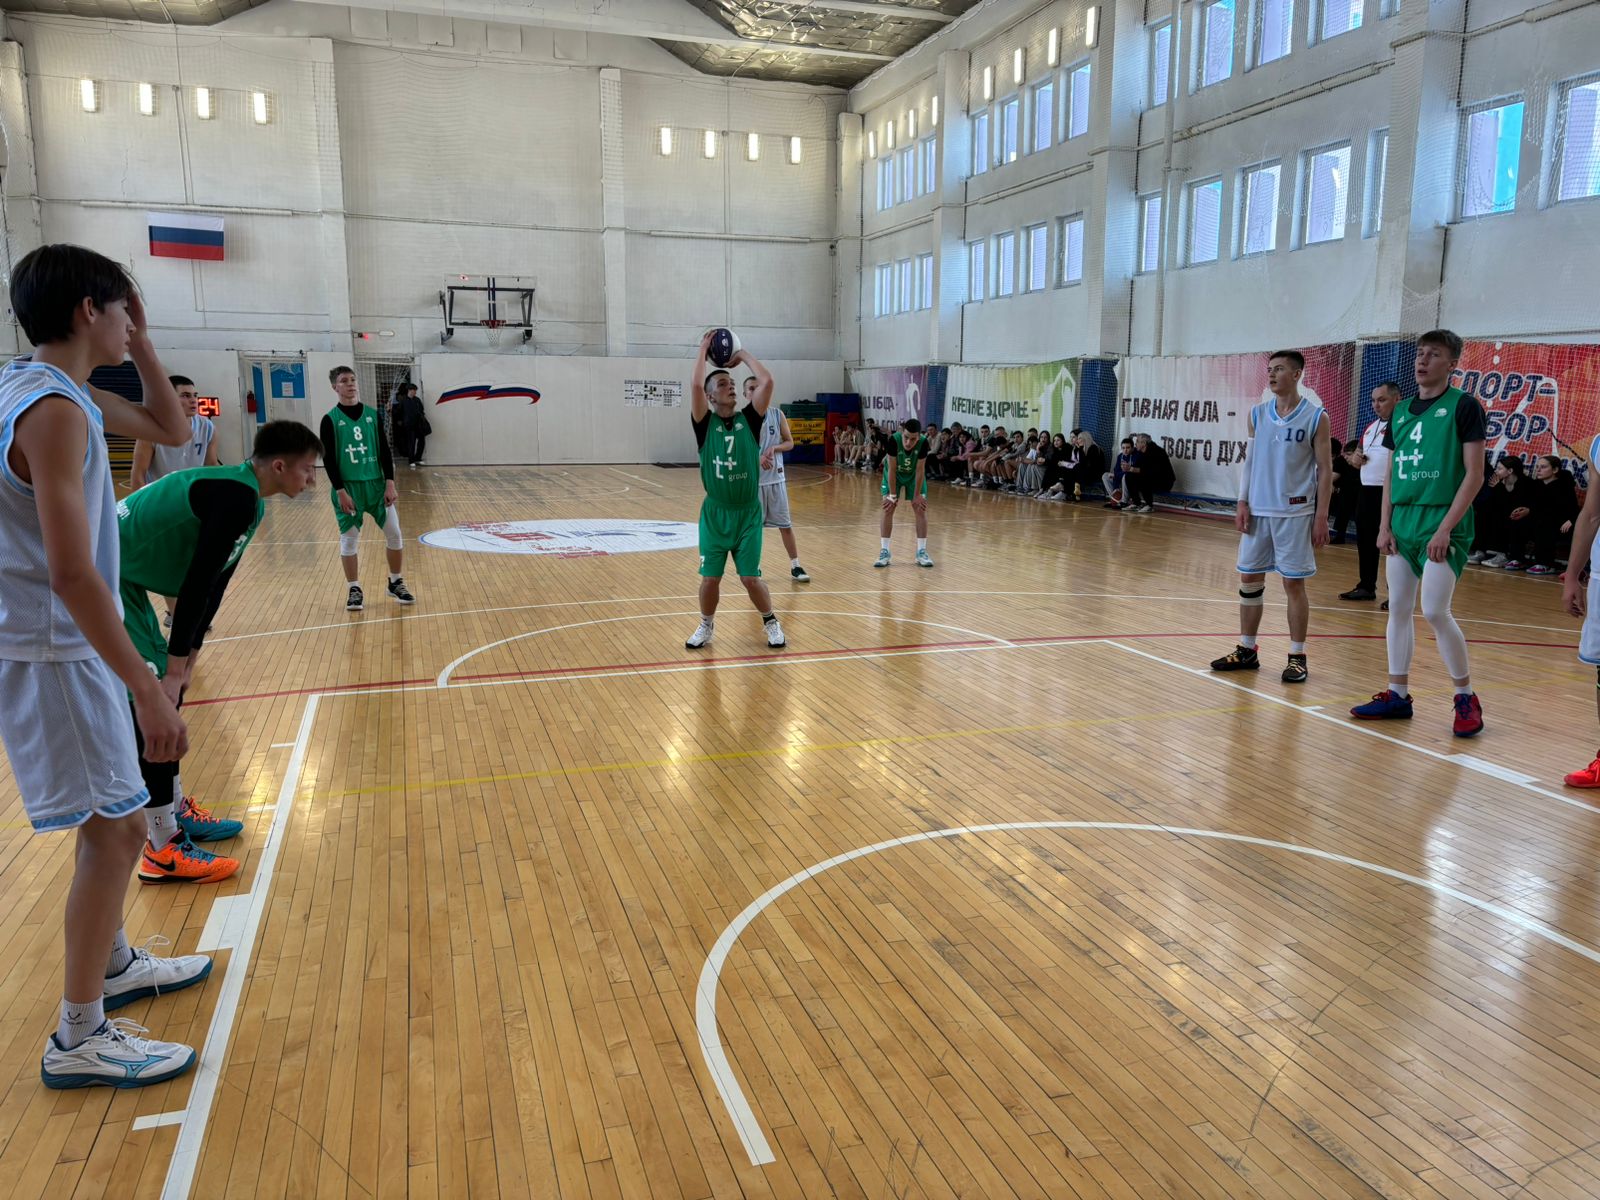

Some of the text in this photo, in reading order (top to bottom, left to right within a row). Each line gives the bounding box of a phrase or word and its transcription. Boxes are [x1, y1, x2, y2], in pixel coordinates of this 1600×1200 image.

[198, 398, 219, 416] 24
[1183, 400, 1219, 423] СИЛА
[353, 426, 363, 441] 8
[768, 425, 775, 435] 5
[1284, 428, 1306, 443] 10
[1409, 421, 1423, 444] 4
[194, 443, 203, 455] 7
[724, 435, 735, 454] 7
[1160, 435, 1248, 467] ТВОЕГО ДУХ
[904, 457, 911, 466] 5
[728, 471, 748, 482] group
[1411, 470, 1440, 481] group
